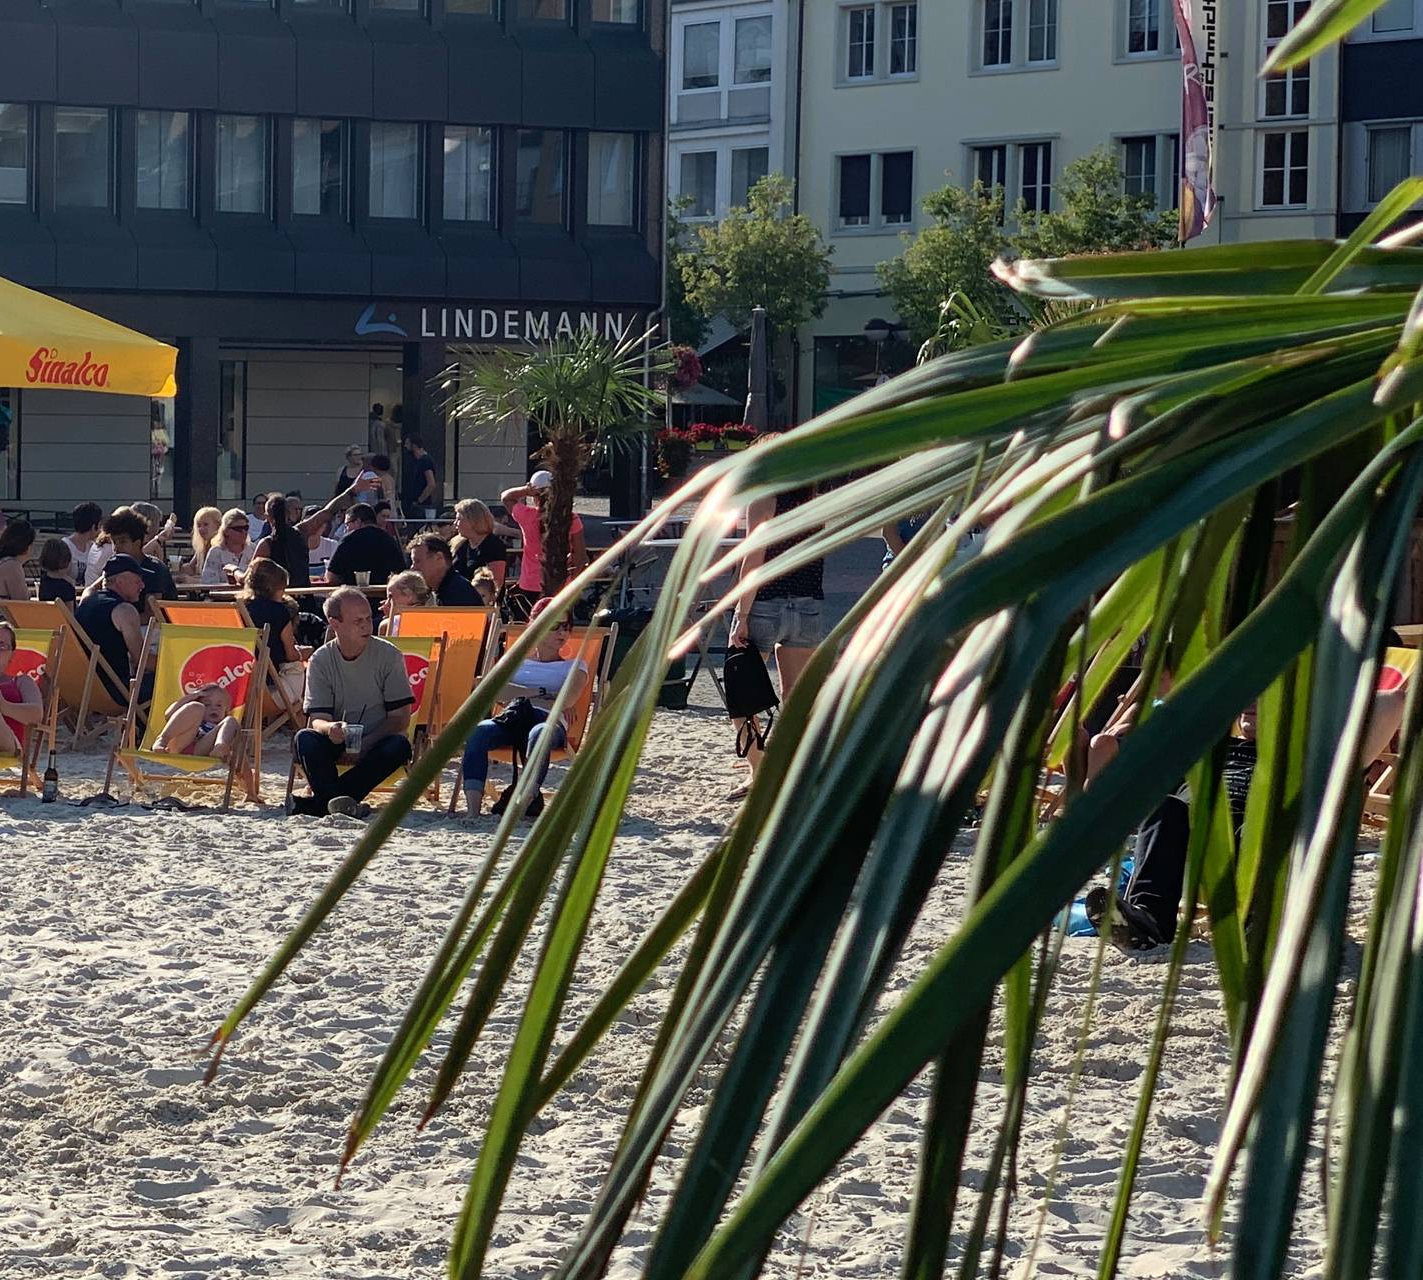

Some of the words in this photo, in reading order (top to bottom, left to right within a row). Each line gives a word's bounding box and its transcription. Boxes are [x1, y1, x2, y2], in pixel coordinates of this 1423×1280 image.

[421, 307, 623, 341] LINDEMANN
[26, 347, 109, 387] Sinalco
[185, 661, 255, 695] Salco
